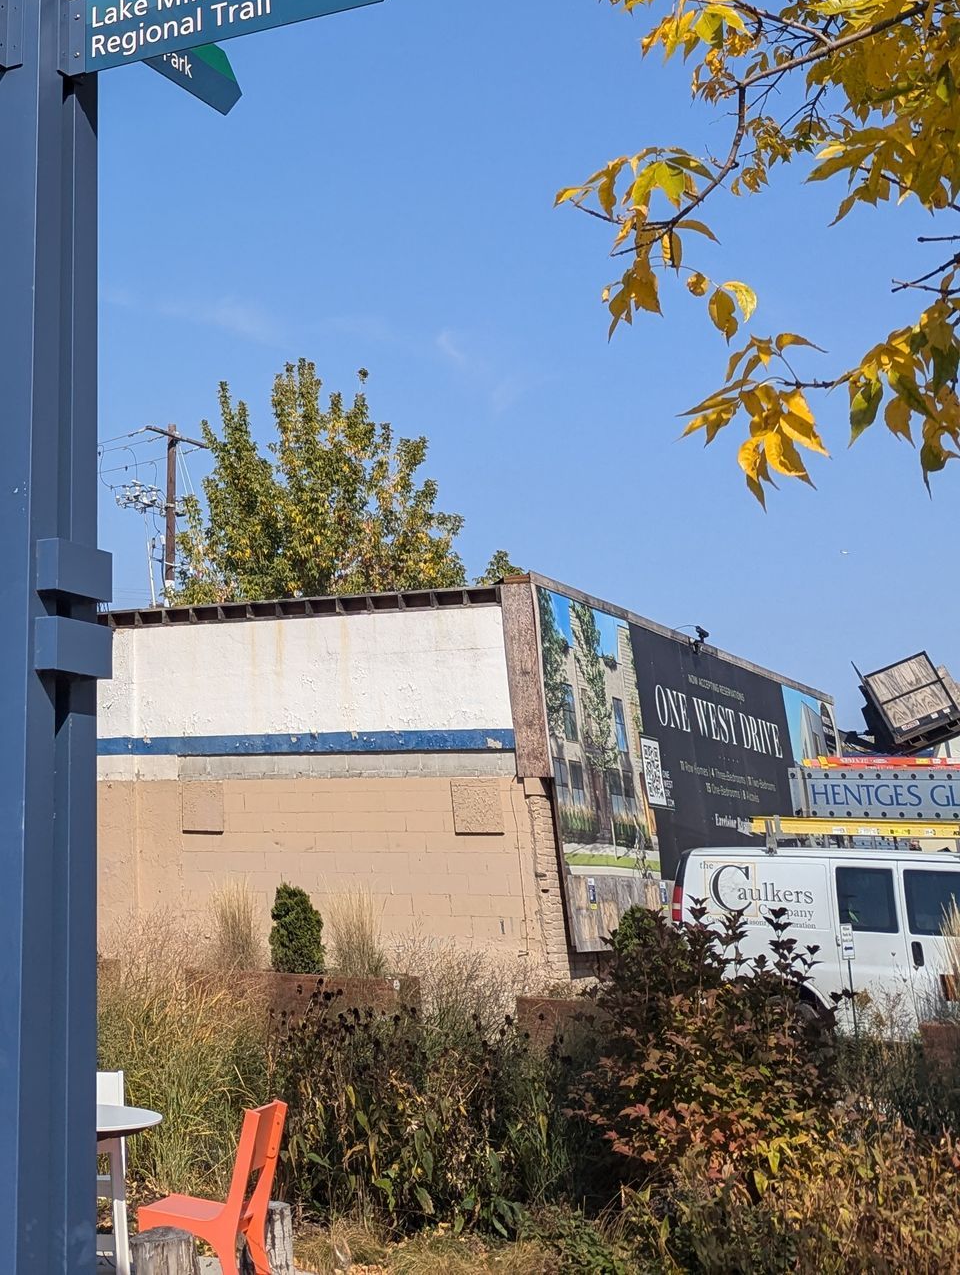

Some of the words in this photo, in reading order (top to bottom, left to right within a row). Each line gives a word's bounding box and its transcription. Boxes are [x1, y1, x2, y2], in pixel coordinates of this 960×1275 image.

[91, 7, 202, 58] Regional
[655, 684, 690, 733] ONE
[692, 697, 738, 745] WEST
[738, 712, 783, 759] DRIVE
[811, 784, 922, 806] HENTGES
[930, 784, 960, 806] GL
[699, 861, 714, 870] the
[709, 864, 814, 912] Caulkers
[758, 904, 814, 920] Cpany
